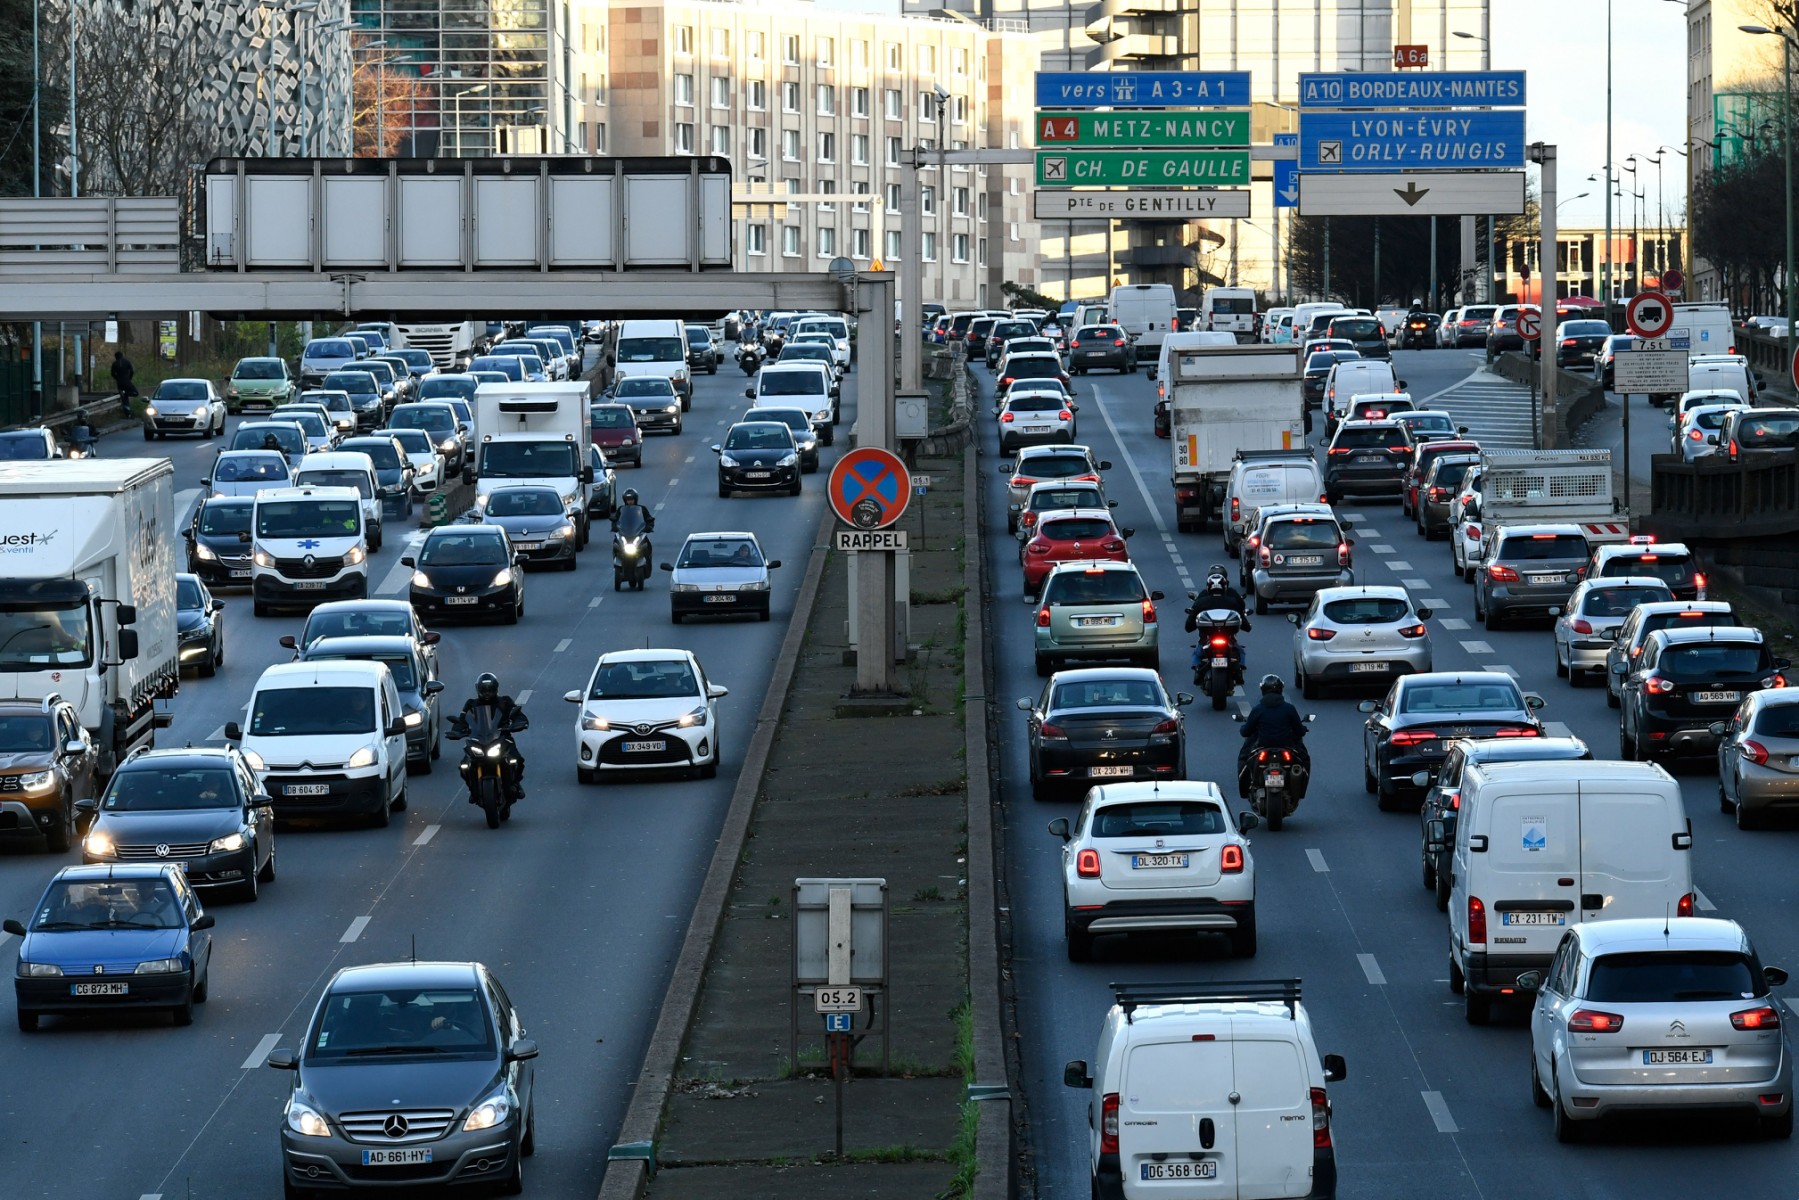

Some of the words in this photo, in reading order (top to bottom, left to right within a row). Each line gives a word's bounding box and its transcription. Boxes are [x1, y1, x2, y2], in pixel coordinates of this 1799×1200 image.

[1062, 84, 1105, 98] vers
[1350, 80, 1518, 98] BORDEAUX-NANTES
[1094, 120, 1236, 138] METZ-NANCY
[1352, 116, 1472, 138] LYON-ÉVRY
[1352, 142, 1506, 160] ORLY-RUNGIS
[1074, 160, 1107, 177] CH.
[1122, 160, 1148, 177] DE
[1162, 160, 1242, 177] GAULLE
[1100, 202, 1114, 210] DE
[1126, 198, 1217, 210] GENTILLY
[1640, 340, 1656, 350] 7.5
[1658, 342, 1663, 350] t
[1178, 444, 1188, 454] 90
[1178, 456, 1188, 466] 80
[841, 534, 902, 548] RAPPEL
[821, 992, 856, 1004] 05.2
[834, 1015, 843, 1028] E
